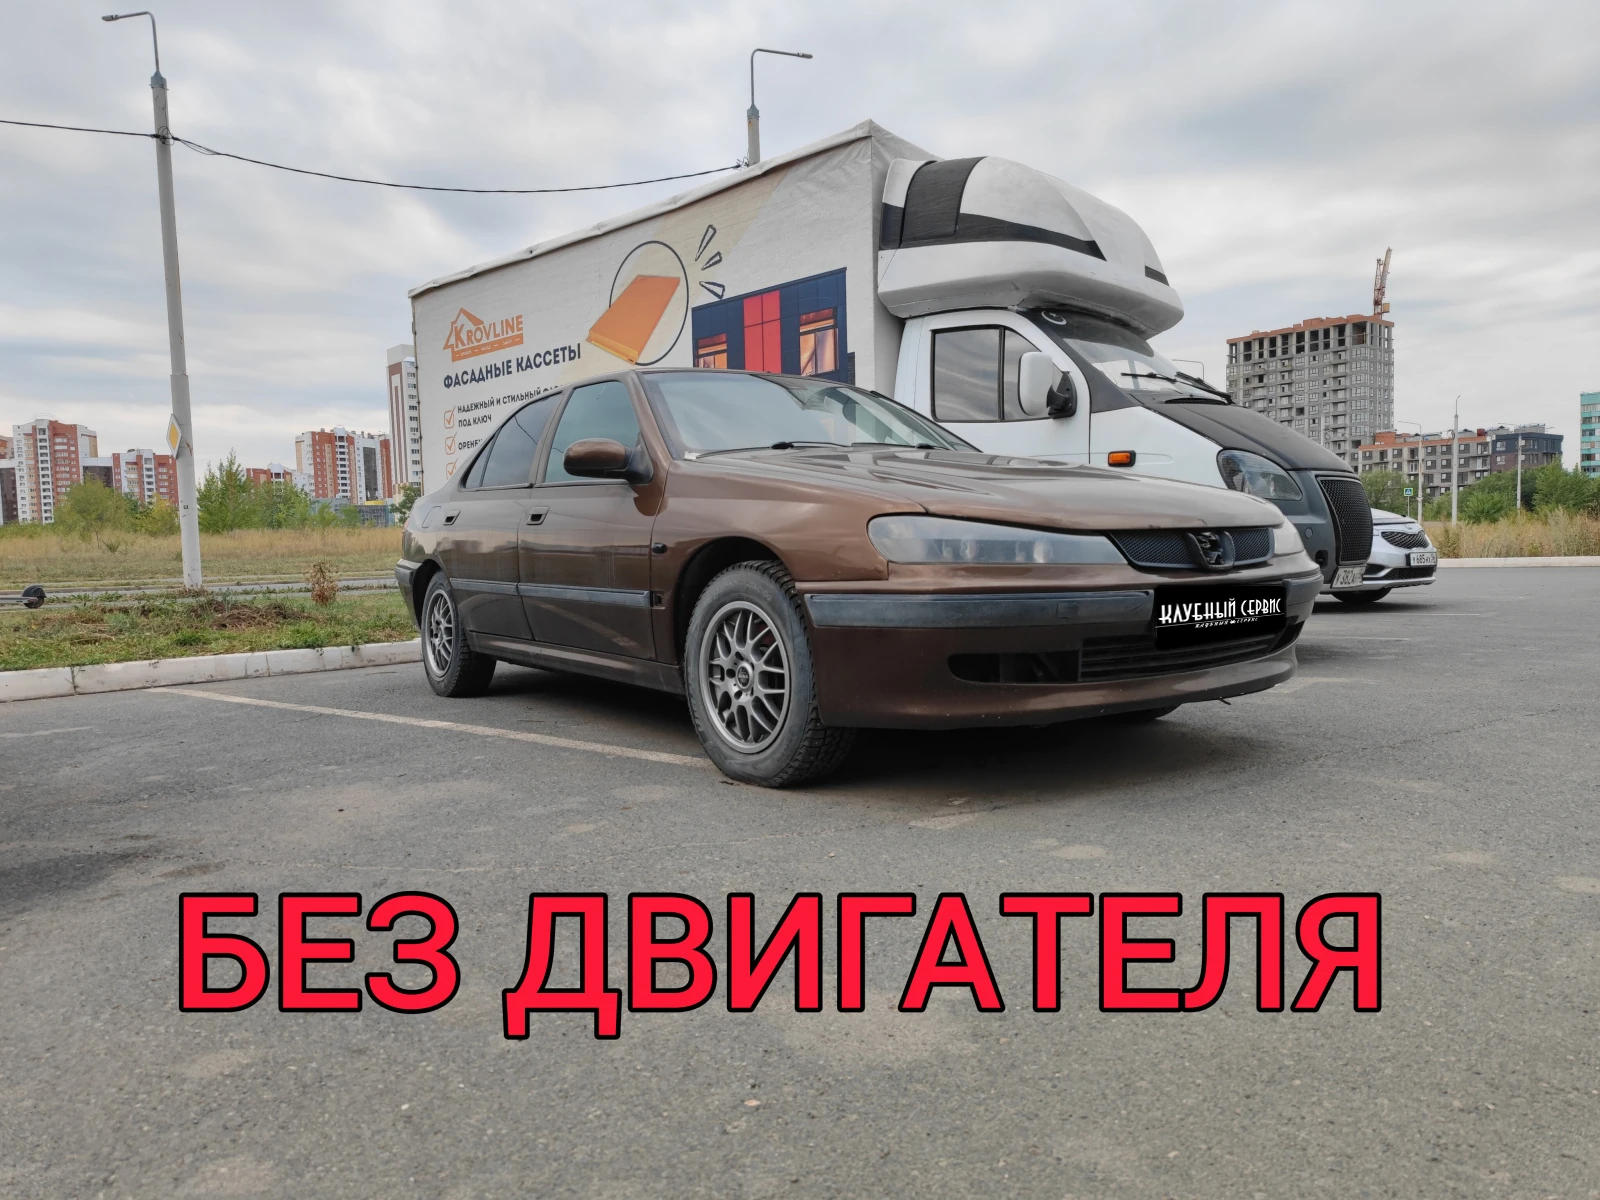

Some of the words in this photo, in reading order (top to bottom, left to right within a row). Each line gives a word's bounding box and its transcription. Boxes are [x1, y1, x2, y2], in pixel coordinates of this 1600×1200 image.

[454, 314, 524, 349] KROVLINE
[443, 359, 513, 389] ФАСАДНЫЕ
[516, 343, 581, 373] КАССЕТЫ
[457, 397, 495, 414] НАДЕЖНЫЙ
[496, 398, 501, 406] И
[458, 418, 472, 428] ПОД
[473, 414, 492, 425] КЛЮЧ
